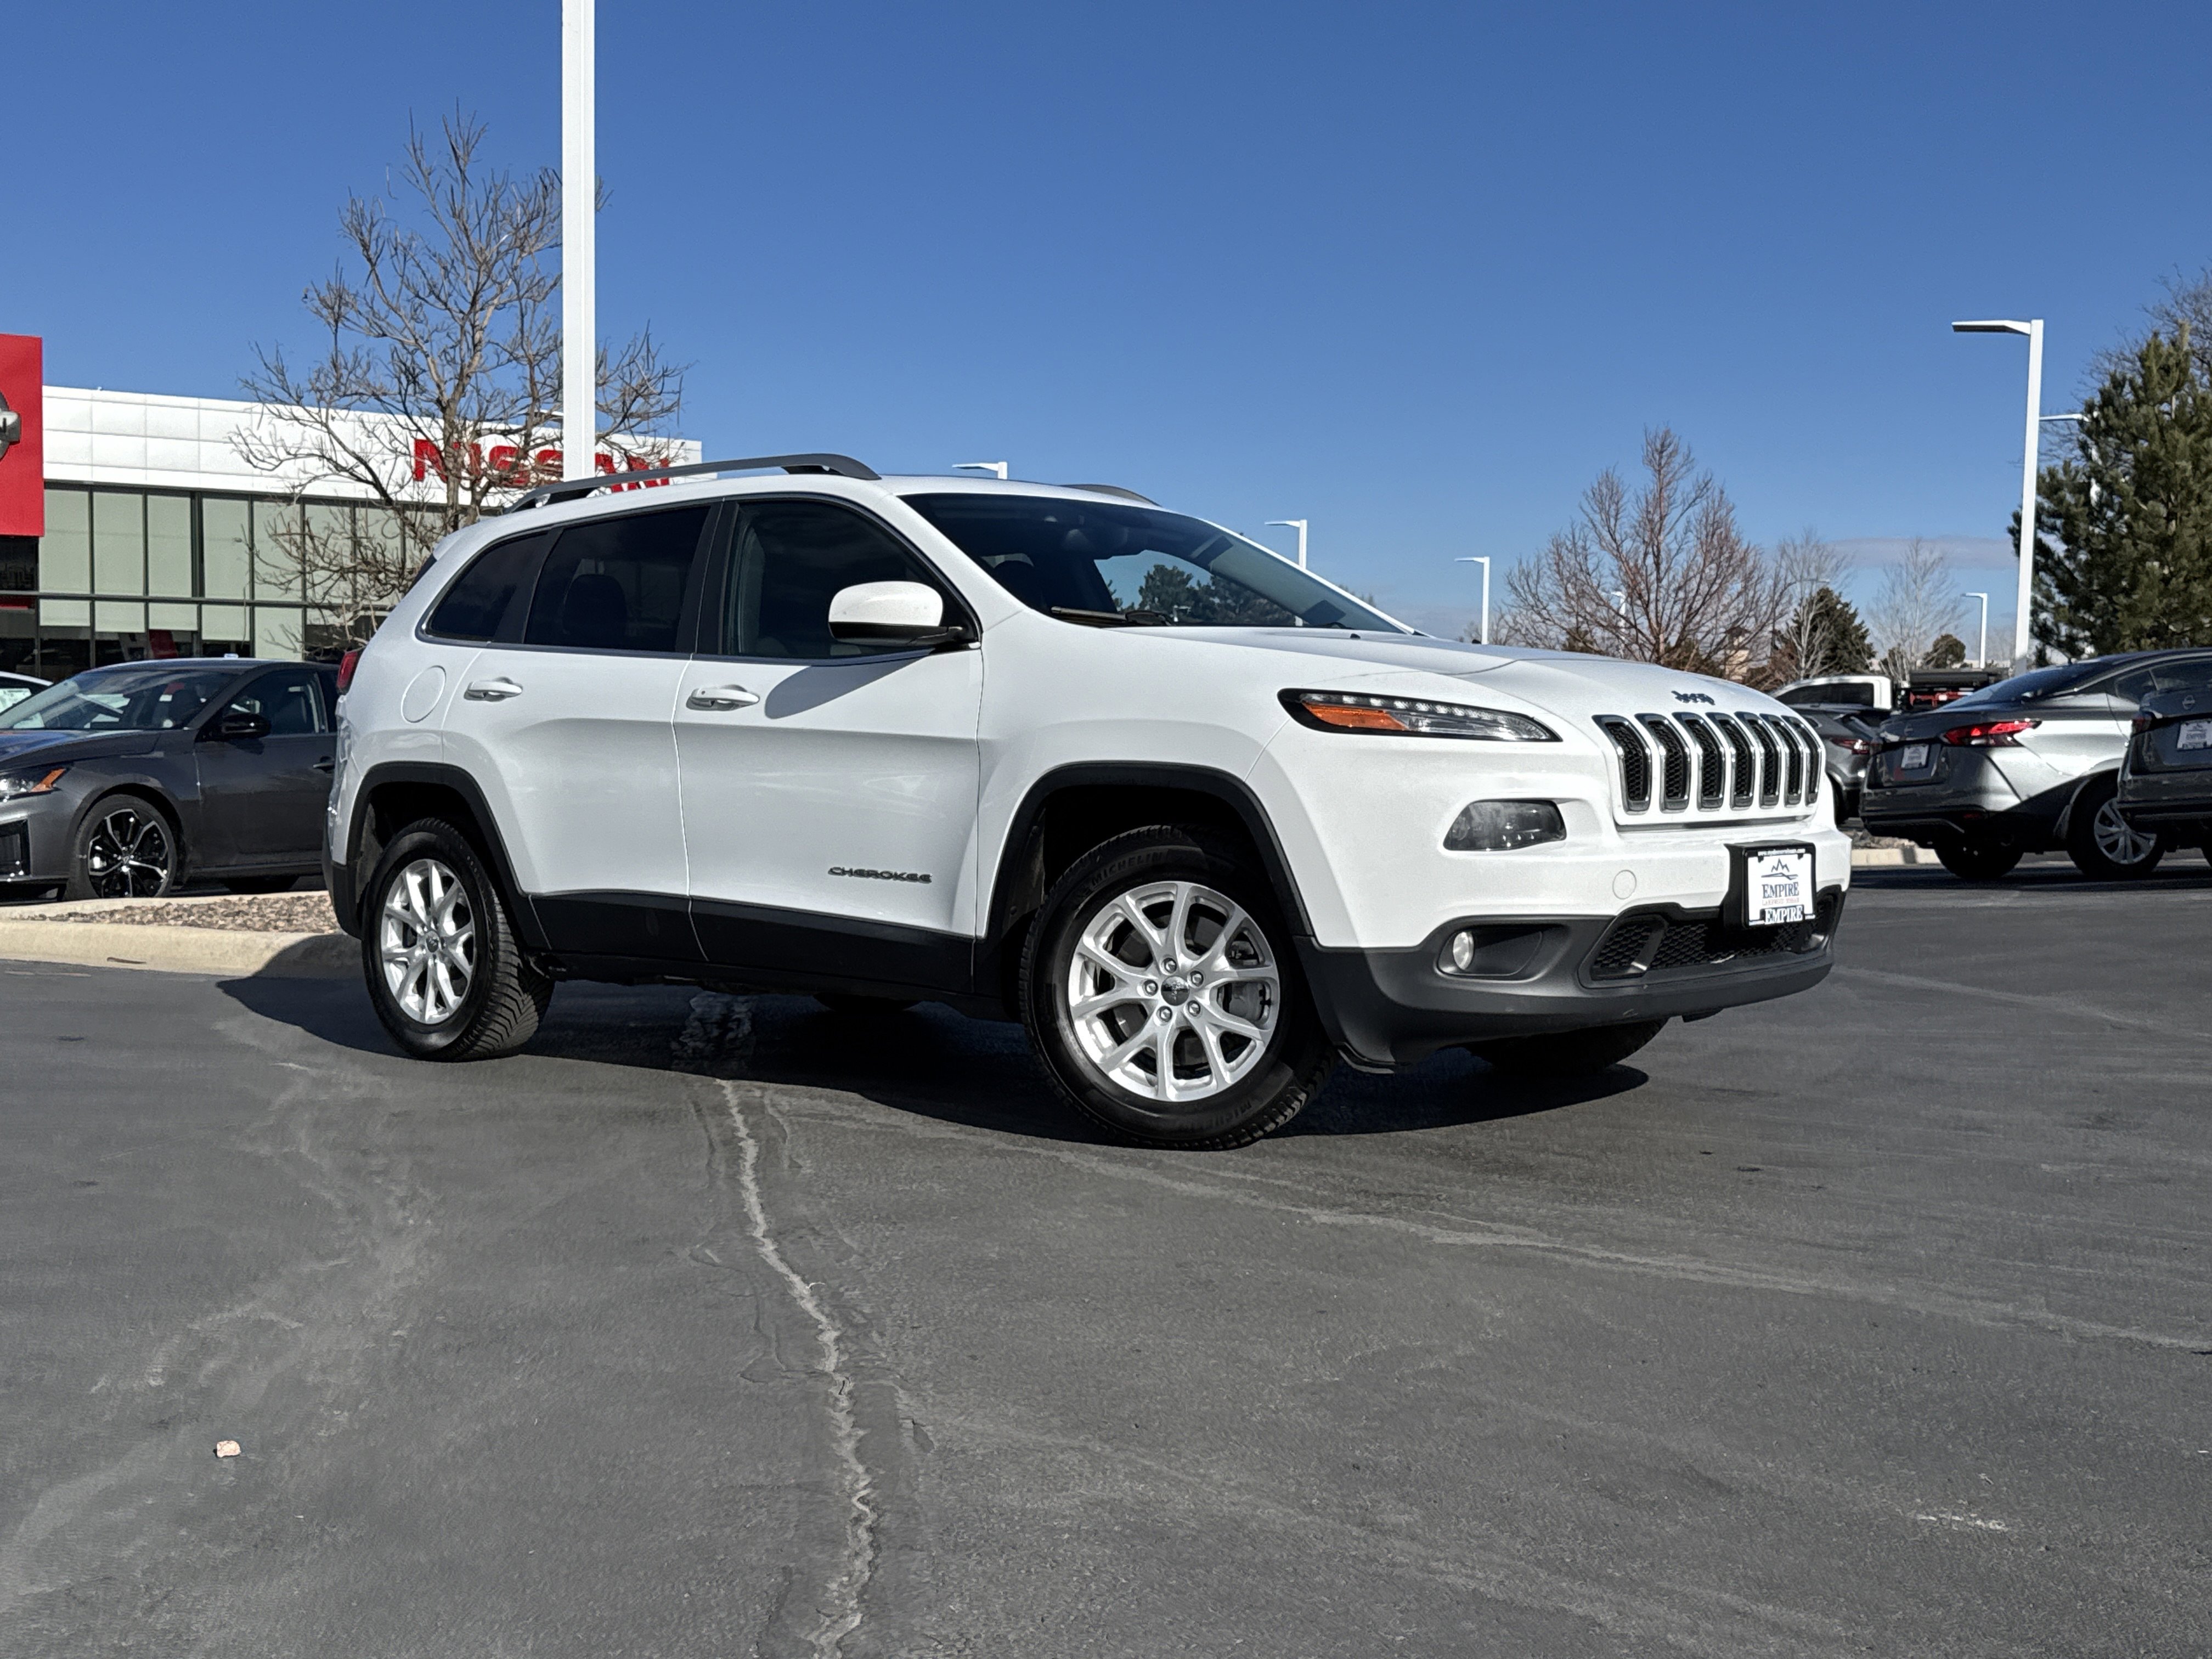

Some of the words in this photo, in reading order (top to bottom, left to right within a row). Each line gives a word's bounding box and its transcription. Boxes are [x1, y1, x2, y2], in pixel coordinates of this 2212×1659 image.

[827, 867, 933, 884] CHEROKEE
[1092, 851, 1164, 886] MICHELIN
[1762, 882, 1799, 899] EMPIRE
[1765, 905, 1803, 925] EMPIRE
